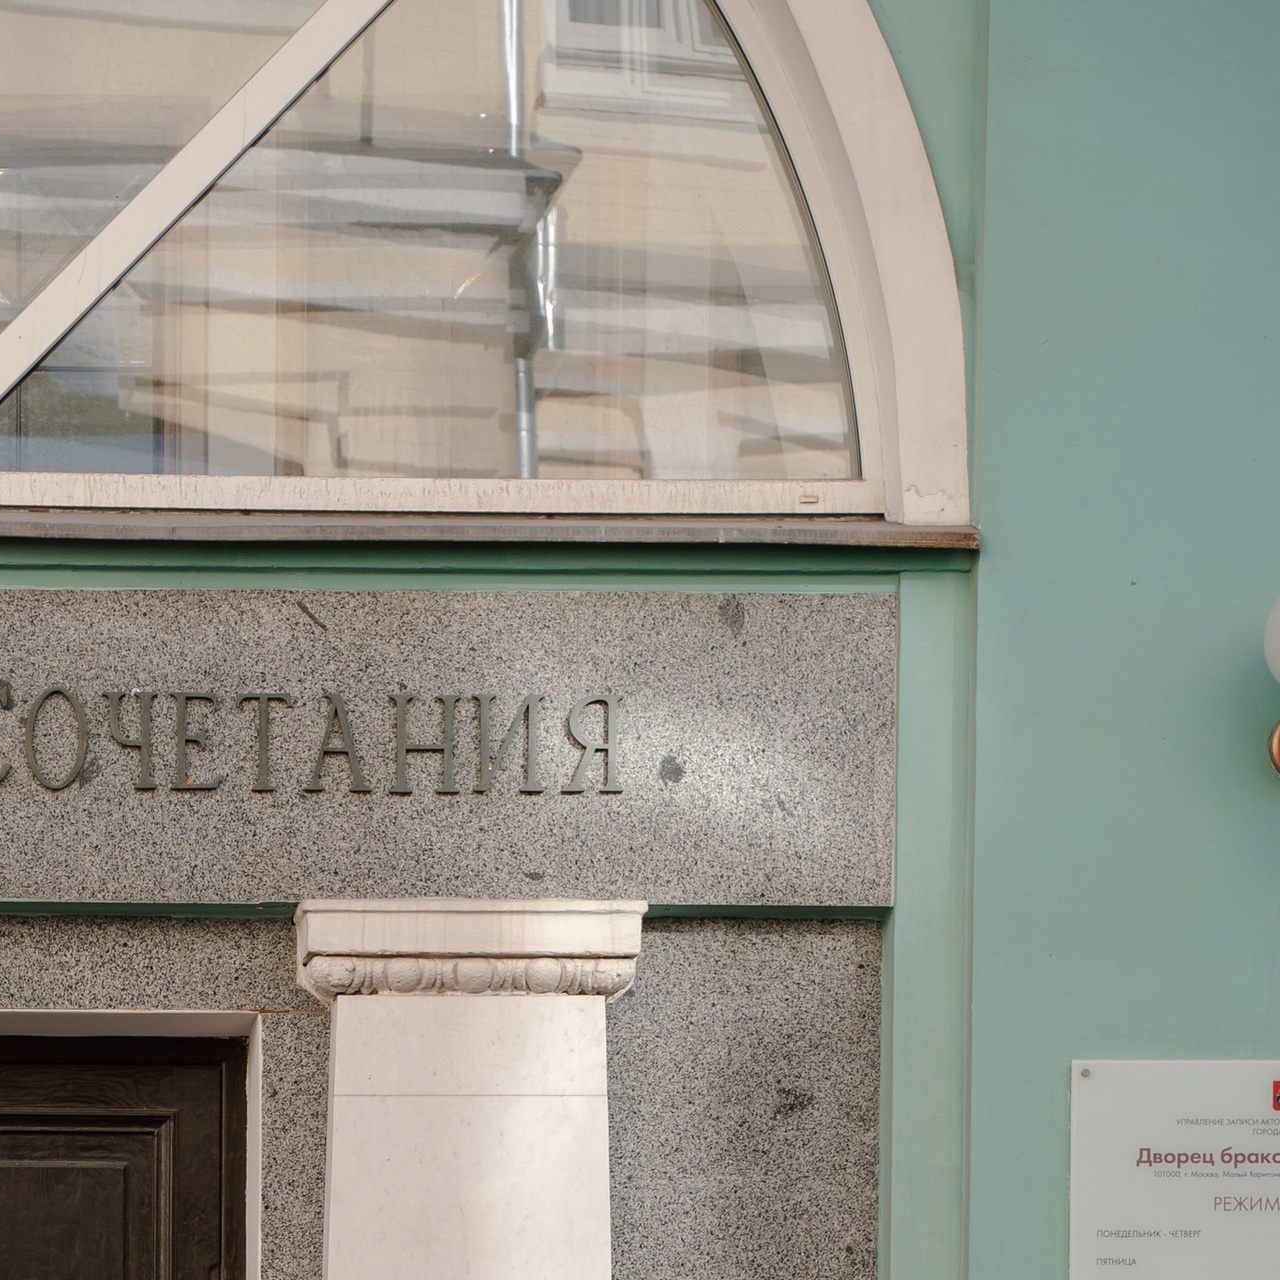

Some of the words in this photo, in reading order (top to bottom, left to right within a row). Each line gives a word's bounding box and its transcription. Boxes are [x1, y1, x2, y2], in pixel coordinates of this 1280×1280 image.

[1176, 1118, 1224, 1126] УПРАВЛЕНИЕ
[1226, 1118, 1259, 1126] ЗАПИСИ
[1136, 1147, 1215, 1169] Дворец
[1222, 1170, 1247, 1178] Малый
[1213, 1196, 1280, 1212] РЕЖИМ
[1096, 1230, 1162, 1239] ПОНЕДЕЛЬНИК
[1168, 1230, 1202, 1238] ЧЕТВЕРГ
[1096, 1258, 1137, 1267] ПЯТНИЦА
